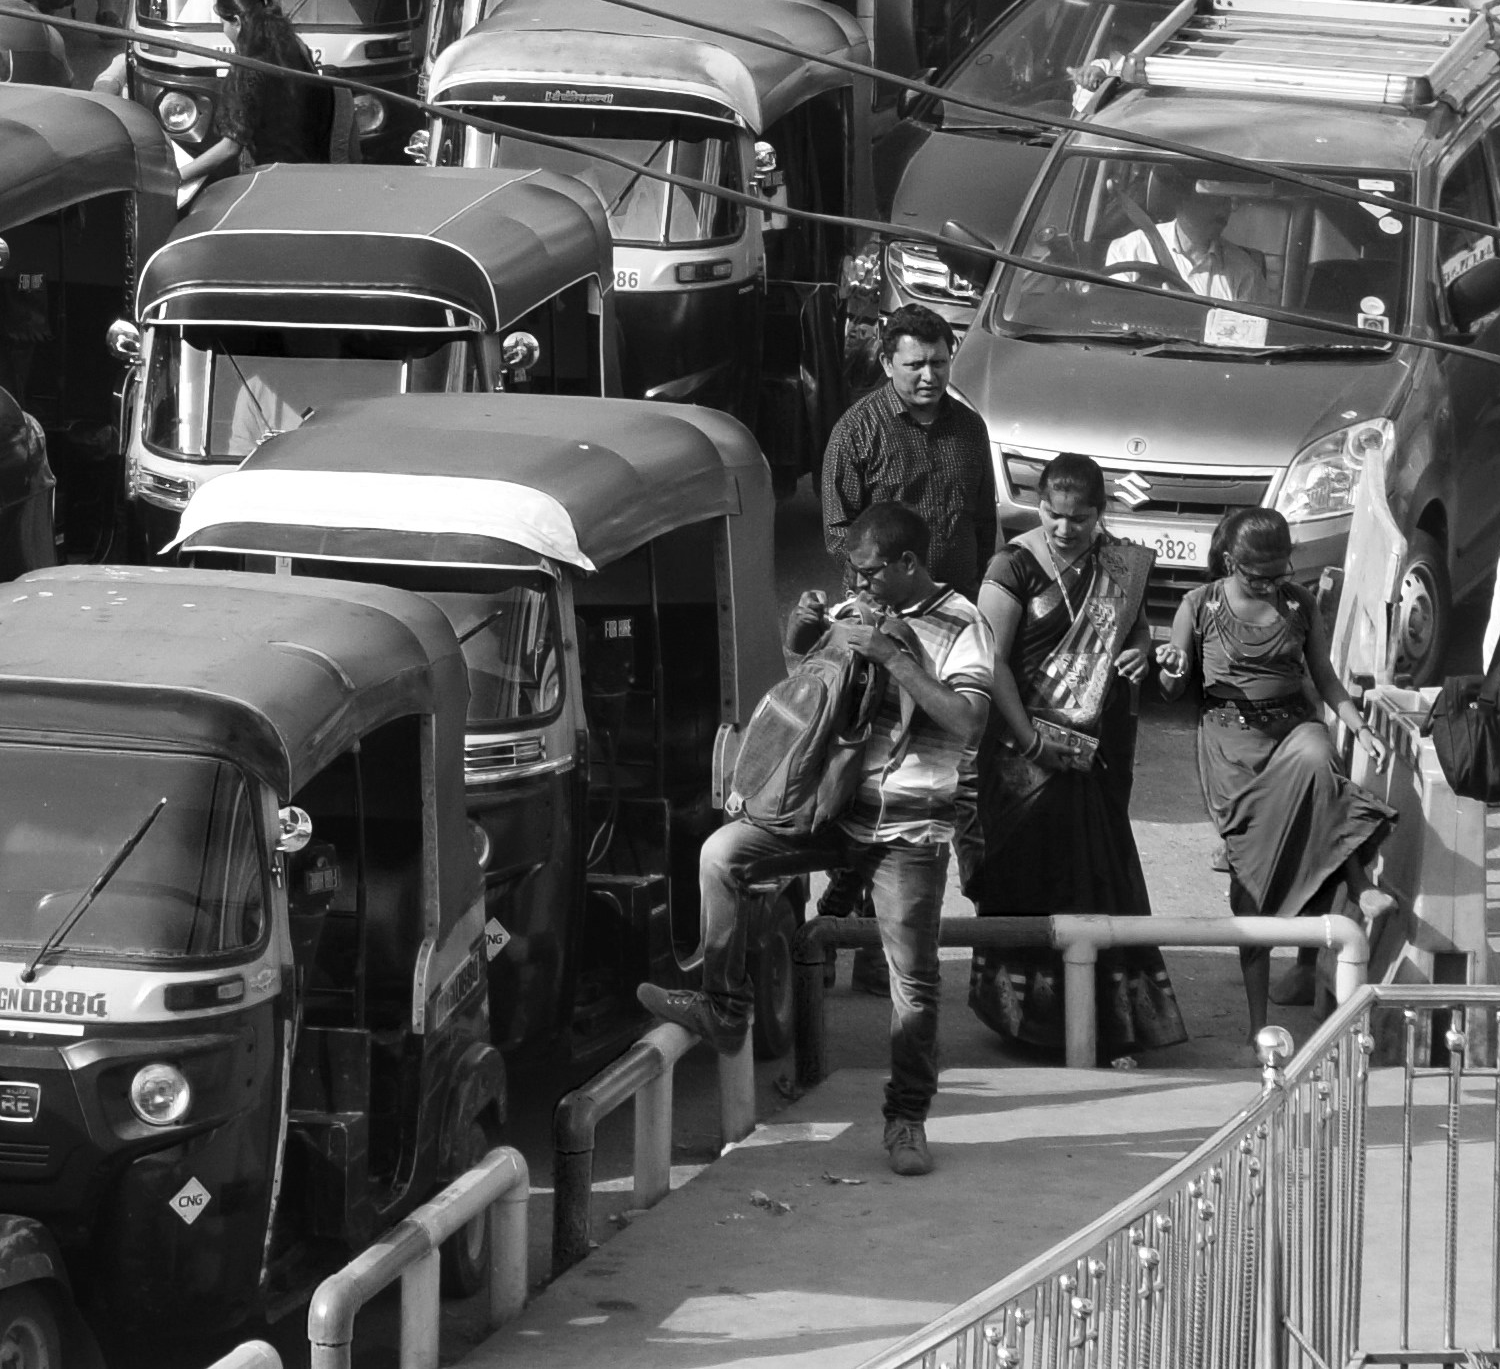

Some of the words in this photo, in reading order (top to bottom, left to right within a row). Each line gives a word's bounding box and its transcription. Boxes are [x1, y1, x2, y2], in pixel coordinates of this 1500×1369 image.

[616, 270, 638, 289] 86
[1155, 538, 1197, 561] 3828
[179, 1194, 203, 1208] CNG
